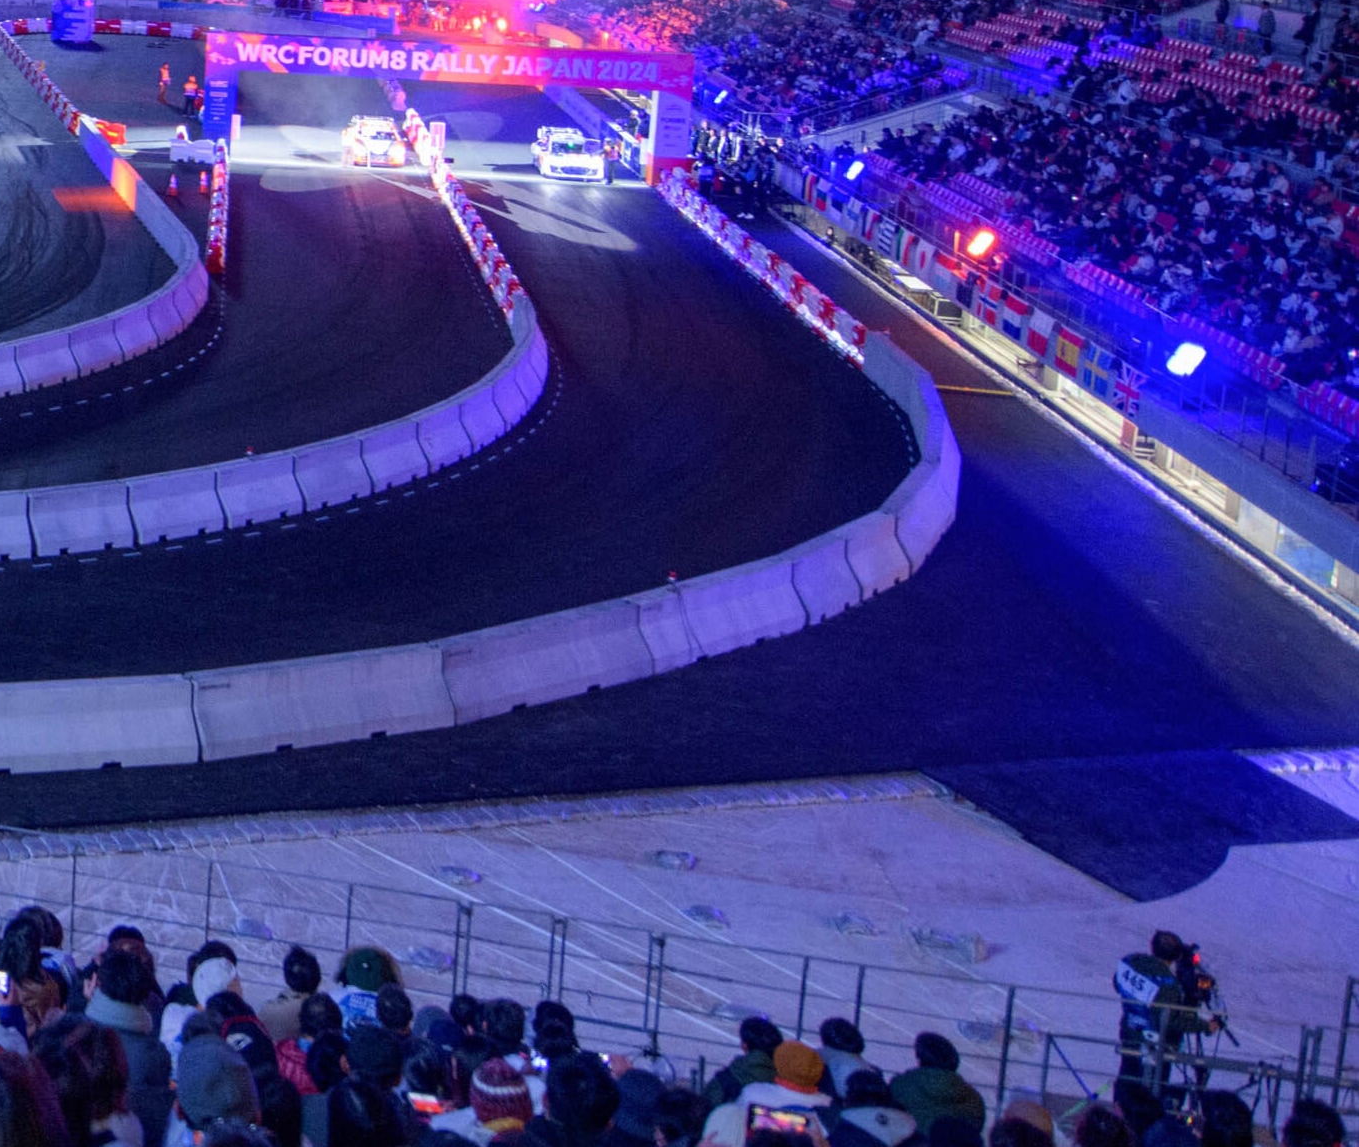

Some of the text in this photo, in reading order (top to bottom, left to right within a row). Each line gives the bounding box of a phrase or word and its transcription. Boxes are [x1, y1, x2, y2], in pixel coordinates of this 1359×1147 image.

[236, 41, 659, 82] WRC FORUM8 RALLY JAPAN 2024
